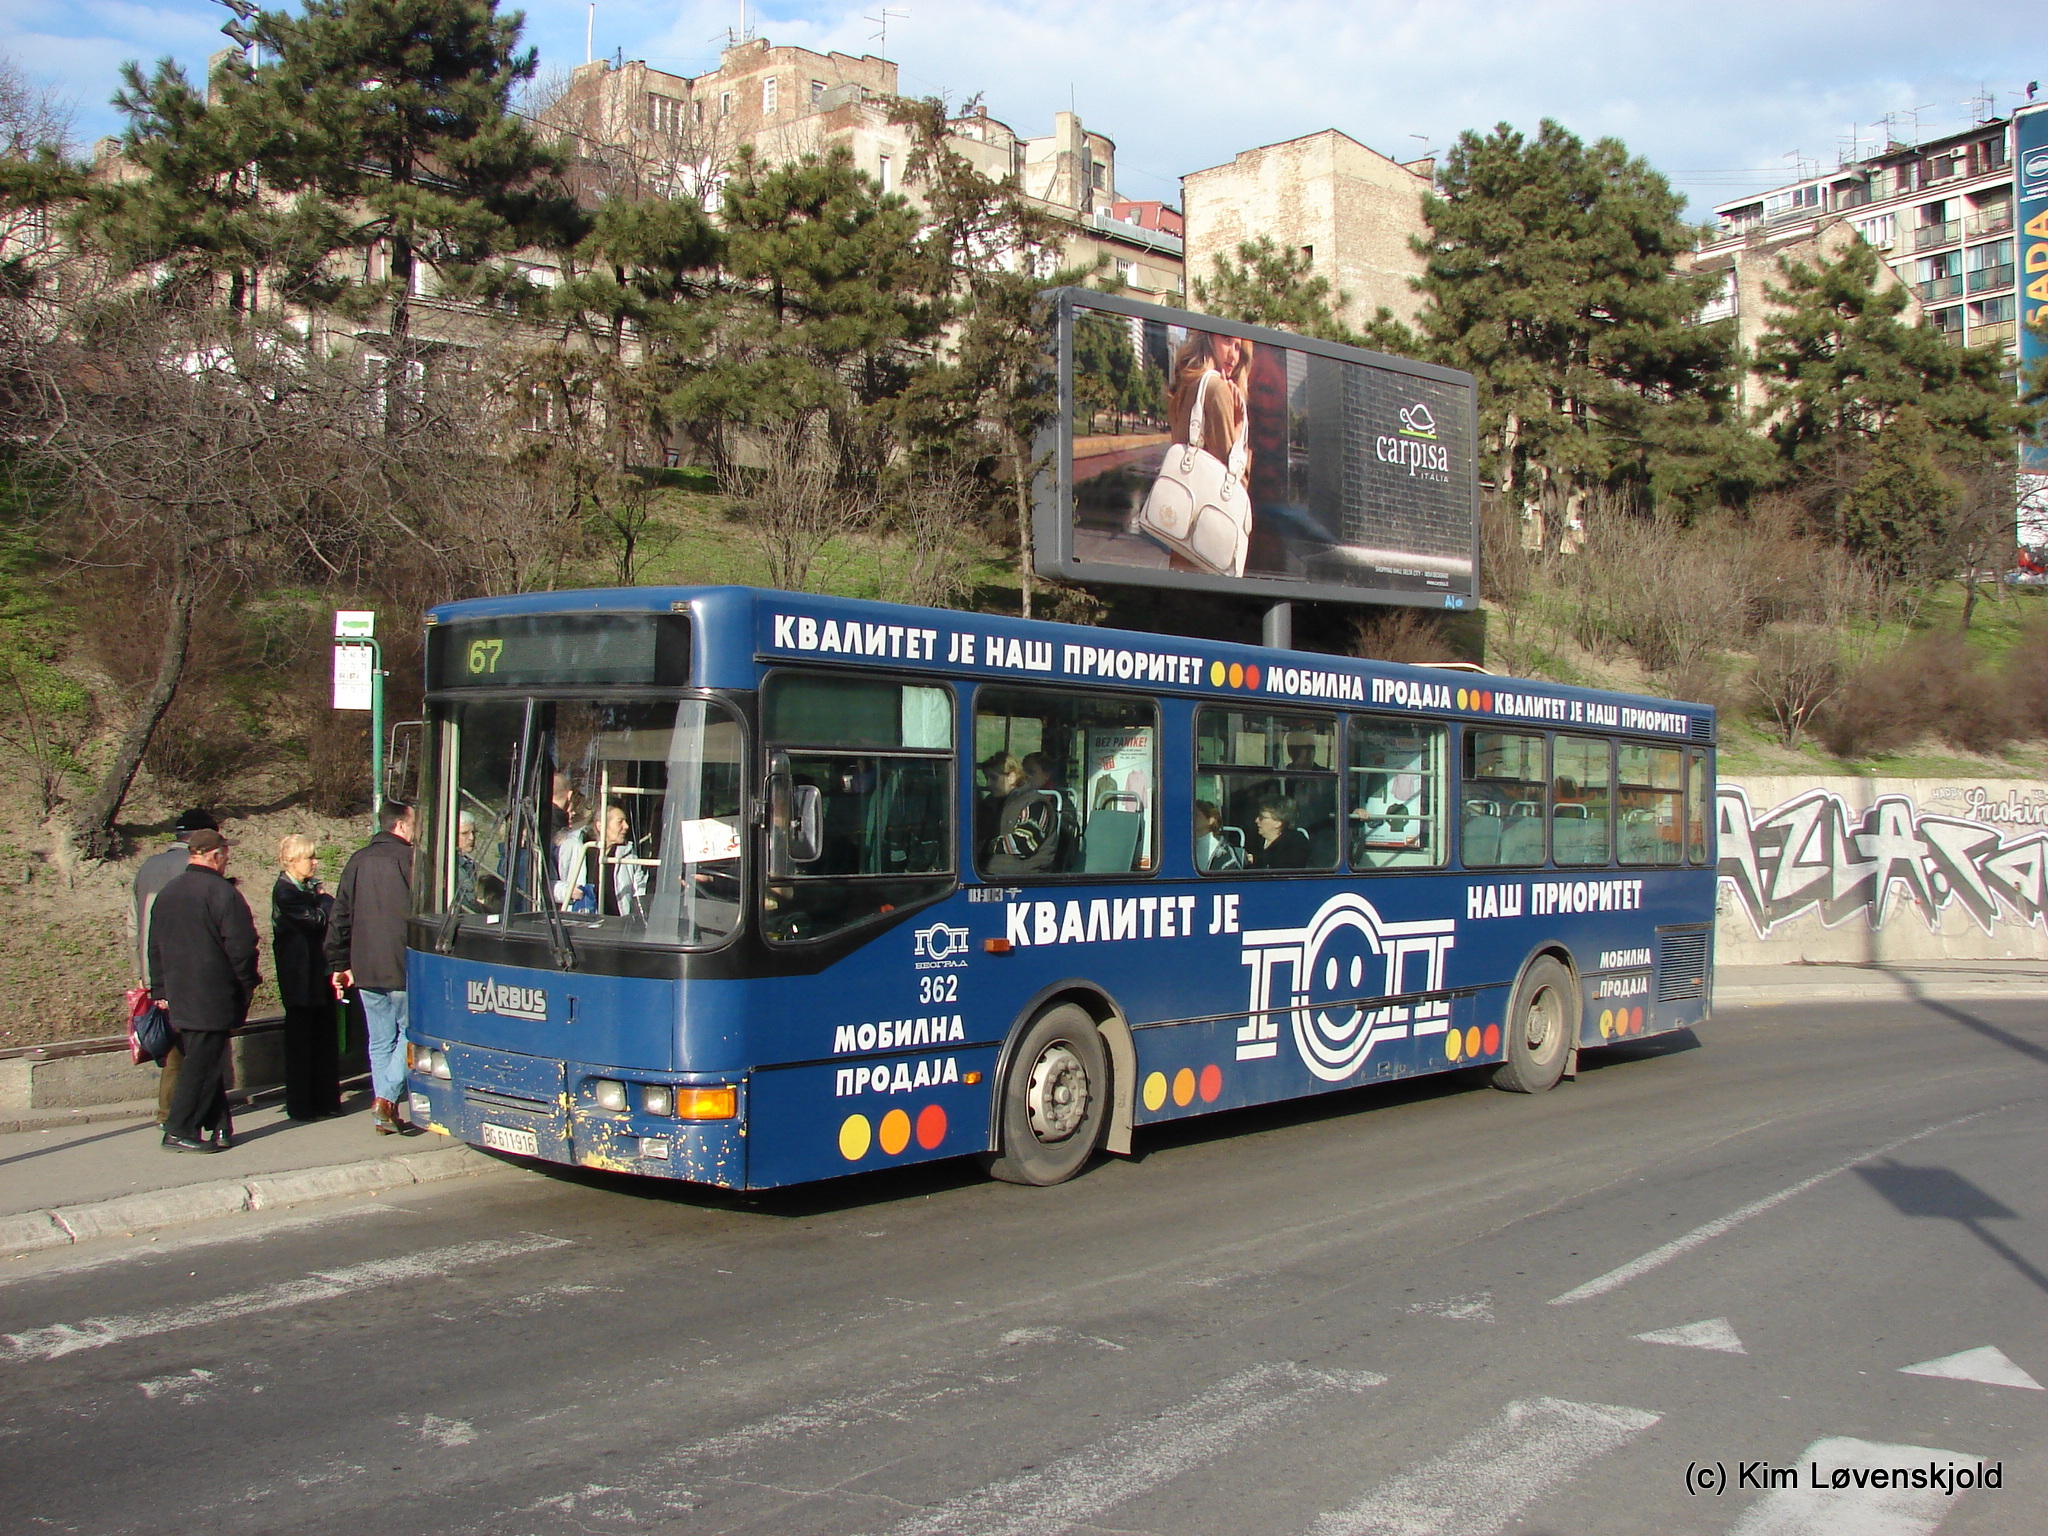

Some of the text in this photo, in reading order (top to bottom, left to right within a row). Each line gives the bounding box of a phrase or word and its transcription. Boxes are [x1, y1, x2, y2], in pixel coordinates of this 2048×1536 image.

[1376, 435, 1449, 476] carpisa
[1421, 472, 1449, 483] ITALIA
[469, 639, 503, 674] 67
[773, 614, 937, 661] КВАЛИТЕТ
[986, 636, 1053, 672] НАШ
[1064, 645, 1204, 686] ПРИОРИТЕТ
[1266, 666, 1452, 711] МОБИЛНА ПРОДАЈА
[1494, 698, 1566, 721] КВАЛИТЕТ
[1586, 702, 1618, 727] НАШ
[1622, 707, 1688, 735] ПРИОРИТЕТ
[1113, 736, 1149, 748] PANIKE!
[1005, 895, 1196, 947] КВАЛИТЕТ
[1467, 883, 1523, 919] НАШ
[1531, 880, 1643, 914] ПРИОРИТЕТ
[1599, 947, 1652, 970] МОБИЛНА
[467, 976, 547, 1016] IKARBUS
[919, 974, 958, 1004] 362
[833, 1014, 965, 1054] МОБИЛНА
[835, 1057, 959, 1097] ПРОДАЈА
